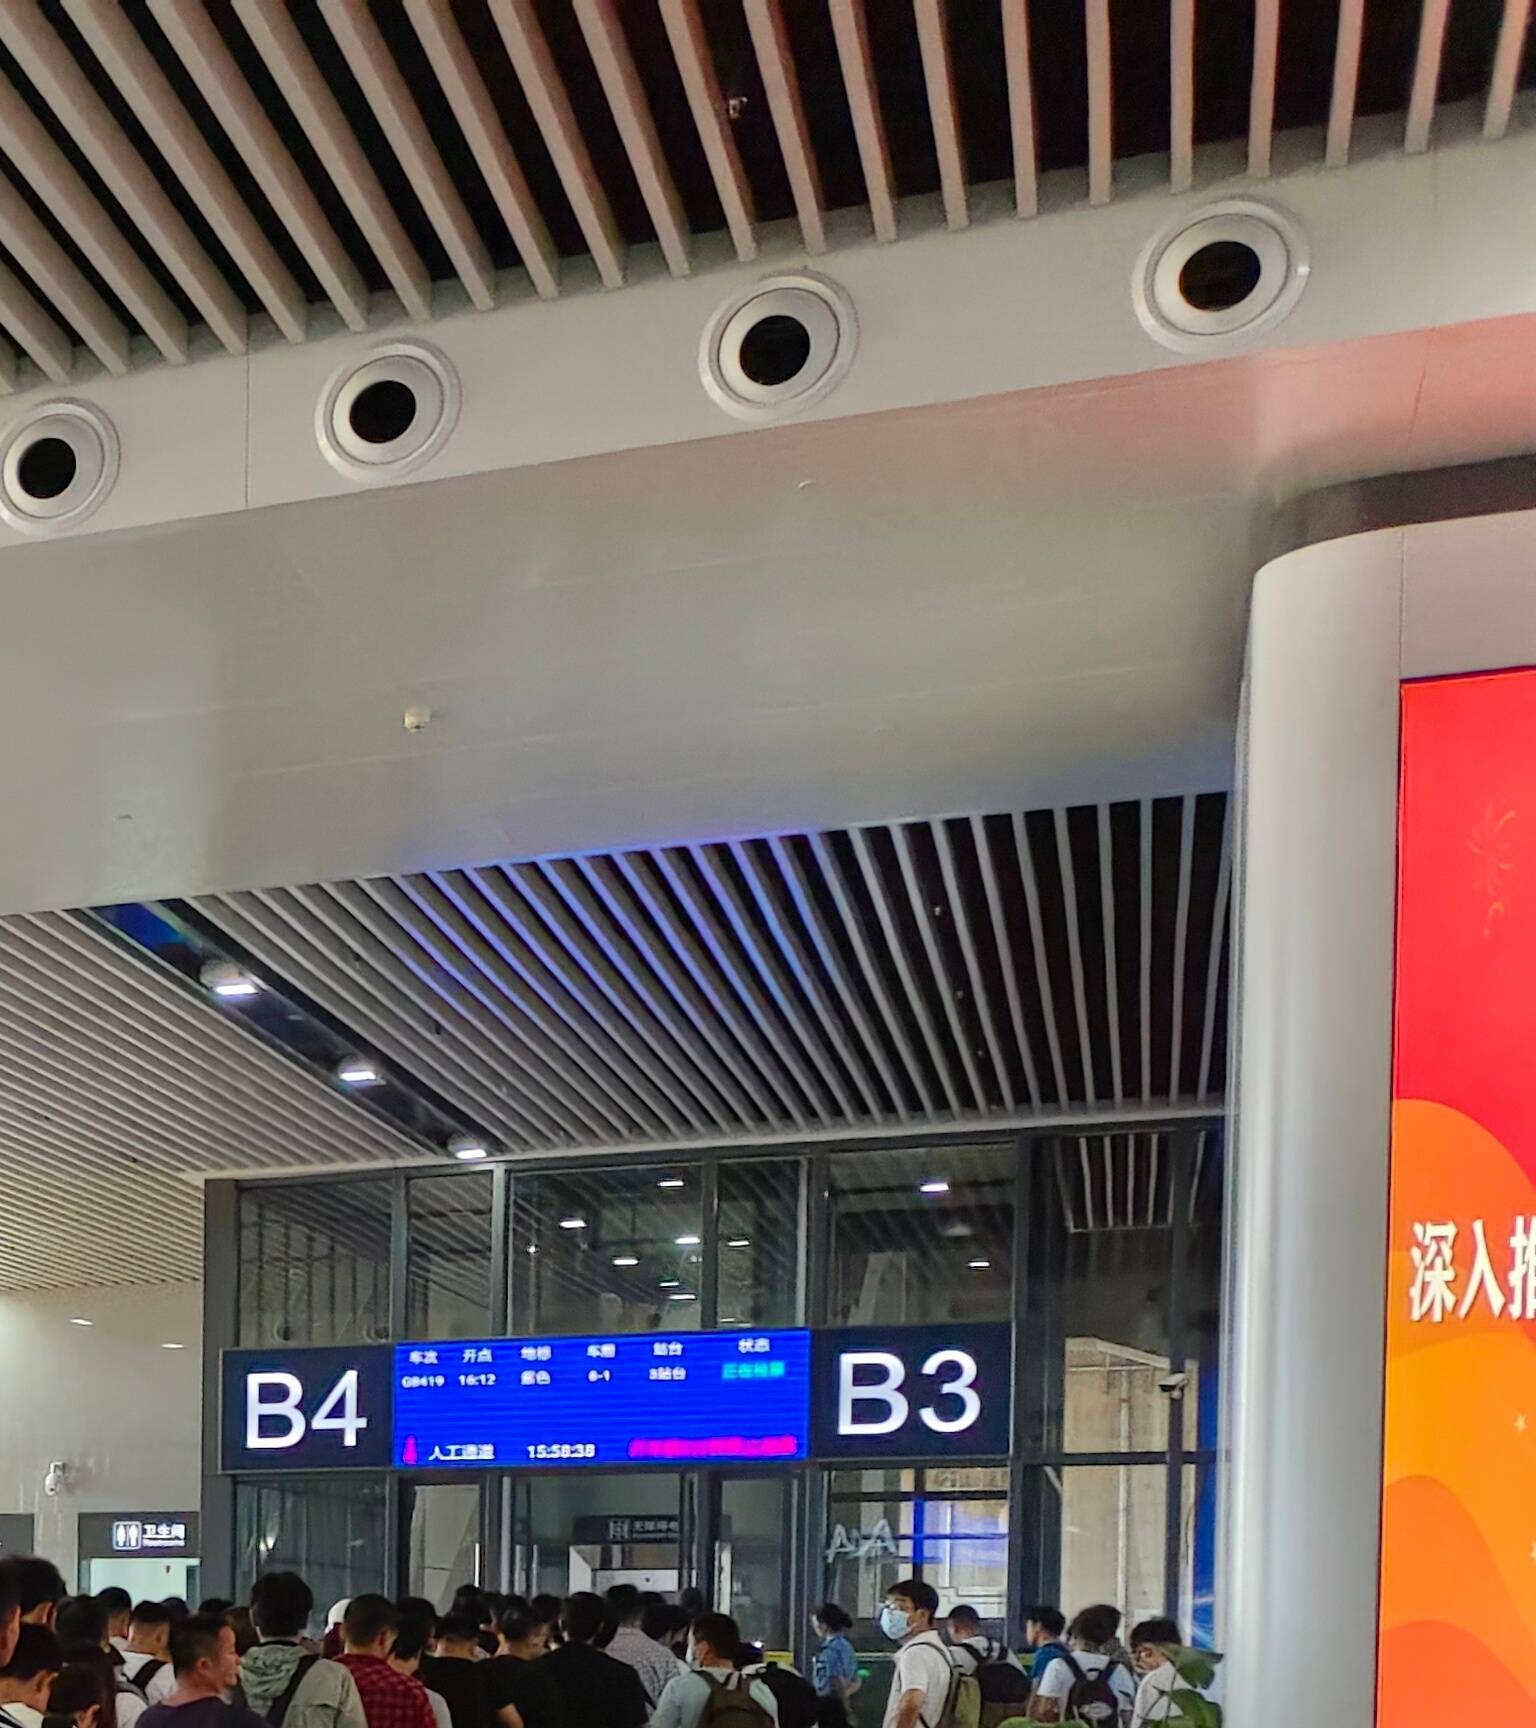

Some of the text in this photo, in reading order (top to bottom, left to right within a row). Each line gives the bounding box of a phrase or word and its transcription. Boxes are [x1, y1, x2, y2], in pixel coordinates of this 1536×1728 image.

[462, 1347, 493, 1363] 开点
[459, 1373, 496, 1386] 16:12
[838, 1350, 981, 1435] B3
[246, 1370, 368, 1449] B4
[143, 1524, 185, 1539] 卫生间
